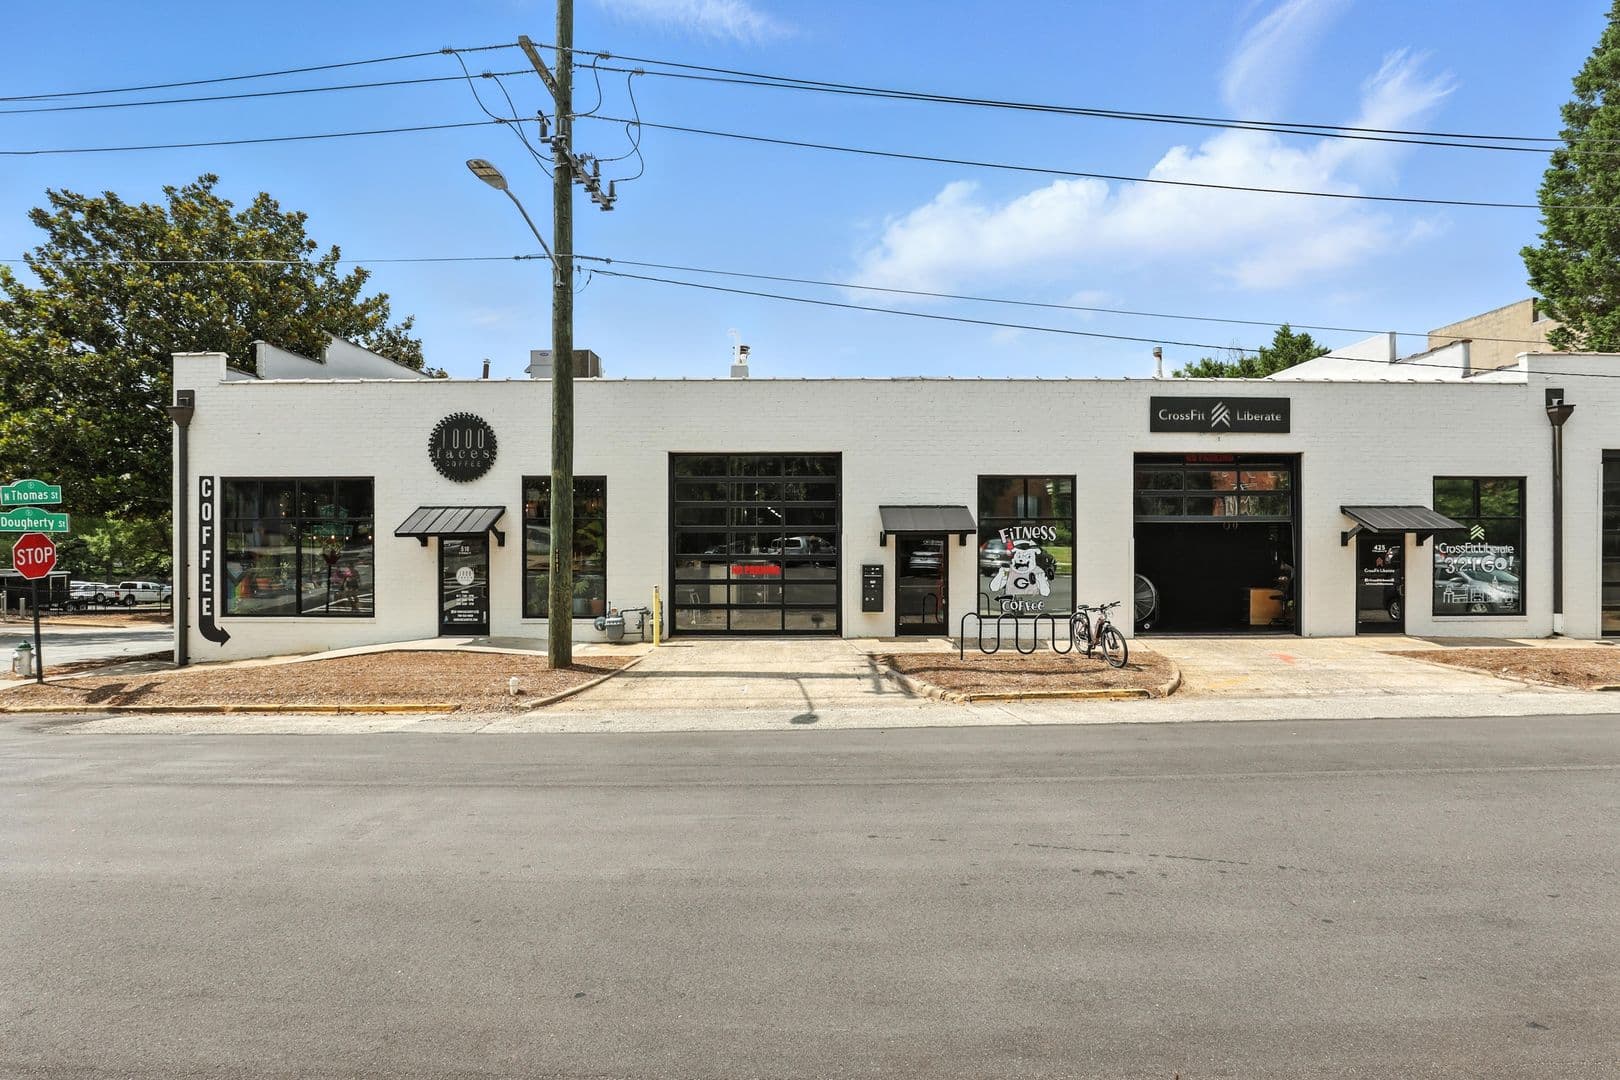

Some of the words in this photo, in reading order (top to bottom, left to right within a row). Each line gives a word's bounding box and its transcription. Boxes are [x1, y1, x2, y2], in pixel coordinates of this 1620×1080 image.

[1158, 409, 1206, 421] CrossFit
[1236, 410, 1282, 421] Liberate
[442, 428, 485, 449] 1000
[4, 493, 10, 501] N
[11, 490, 49, 501] Thomas
[50, 491, 58, 500] St
[0, 516, 55, 530] Dougherty
[57, 520, 66, 528] St
[201, 478, 212, 616] COFFEE
[16, 546, 53, 566] STOP
